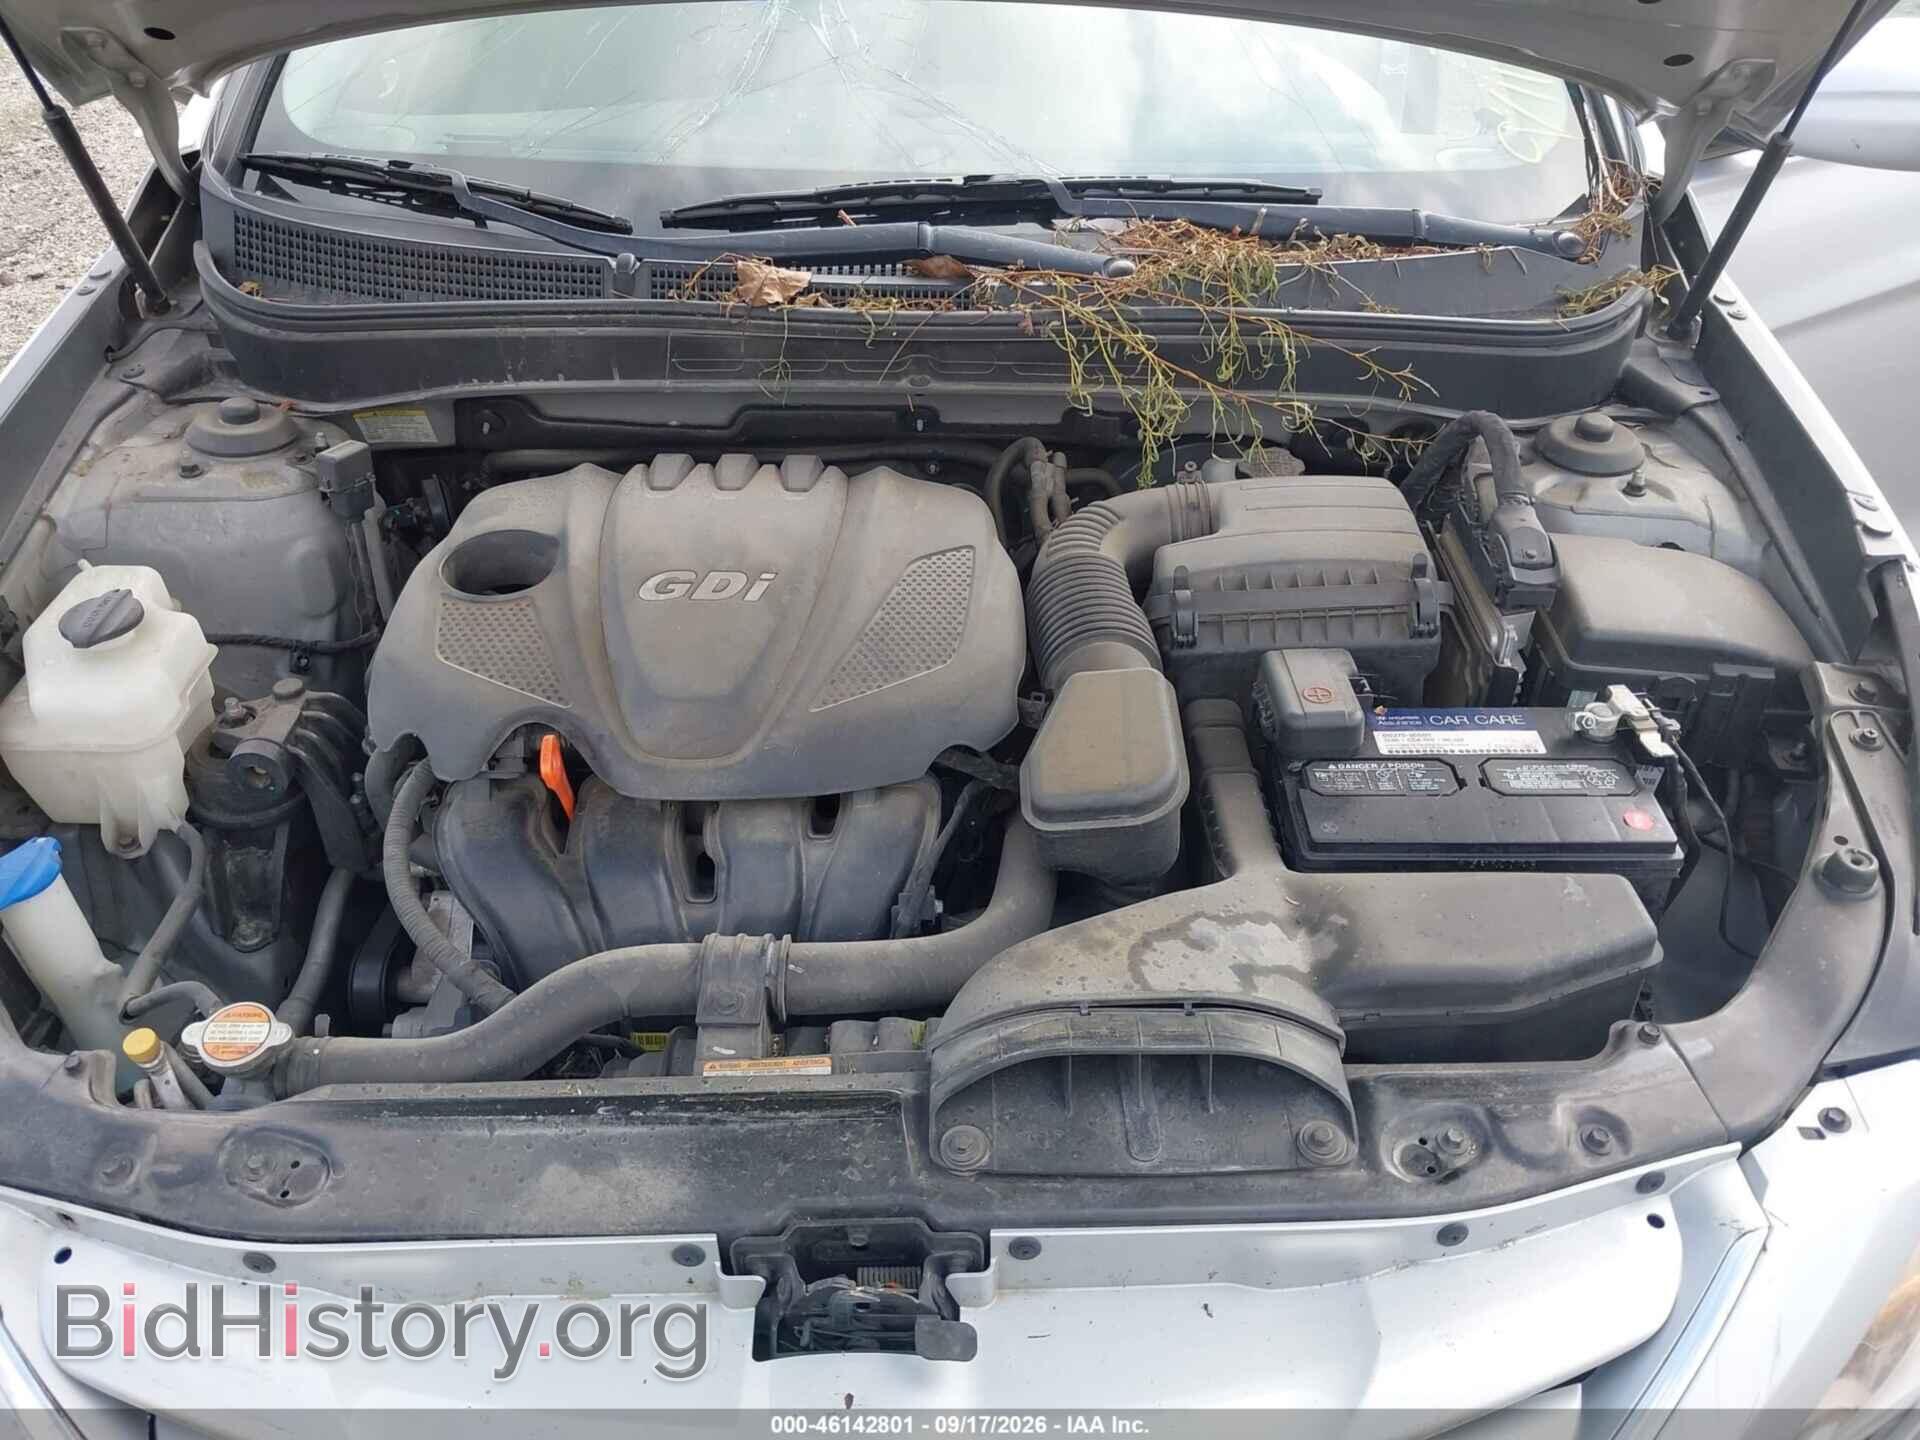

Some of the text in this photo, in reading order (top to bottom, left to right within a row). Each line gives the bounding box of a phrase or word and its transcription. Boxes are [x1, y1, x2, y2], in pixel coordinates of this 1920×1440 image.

[638, 570, 778, 601] GDi
[1429, 715, 1469, 725] CAR
[1474, 714, 1526, 725] CARE
